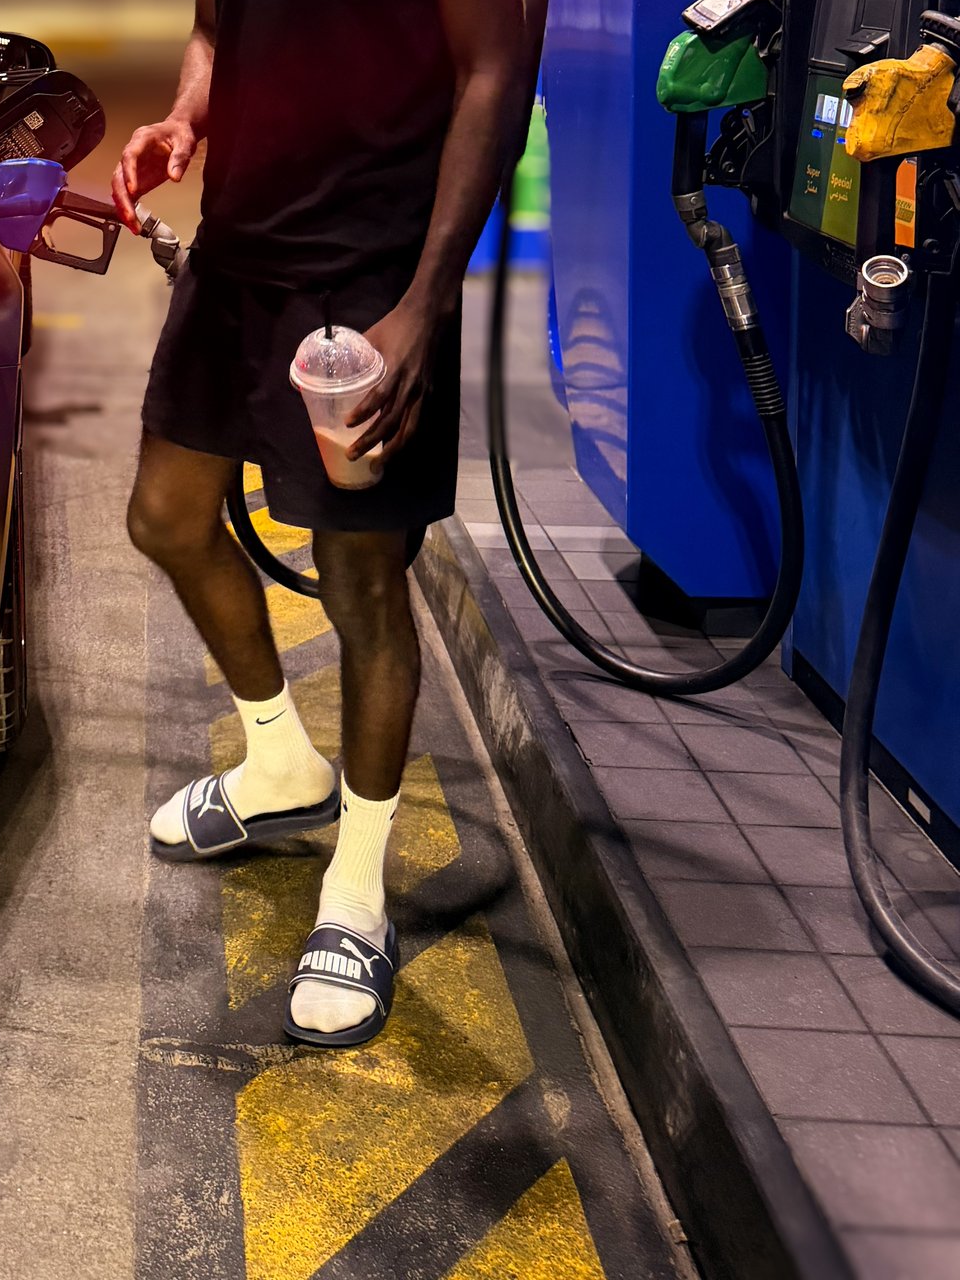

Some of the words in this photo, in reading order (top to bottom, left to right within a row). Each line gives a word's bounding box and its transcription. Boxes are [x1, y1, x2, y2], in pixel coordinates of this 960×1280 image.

[806, 164, 821, 178] Super
[831, 173, 853, 190] Special
[298, 950, 362, 980] PUMA
